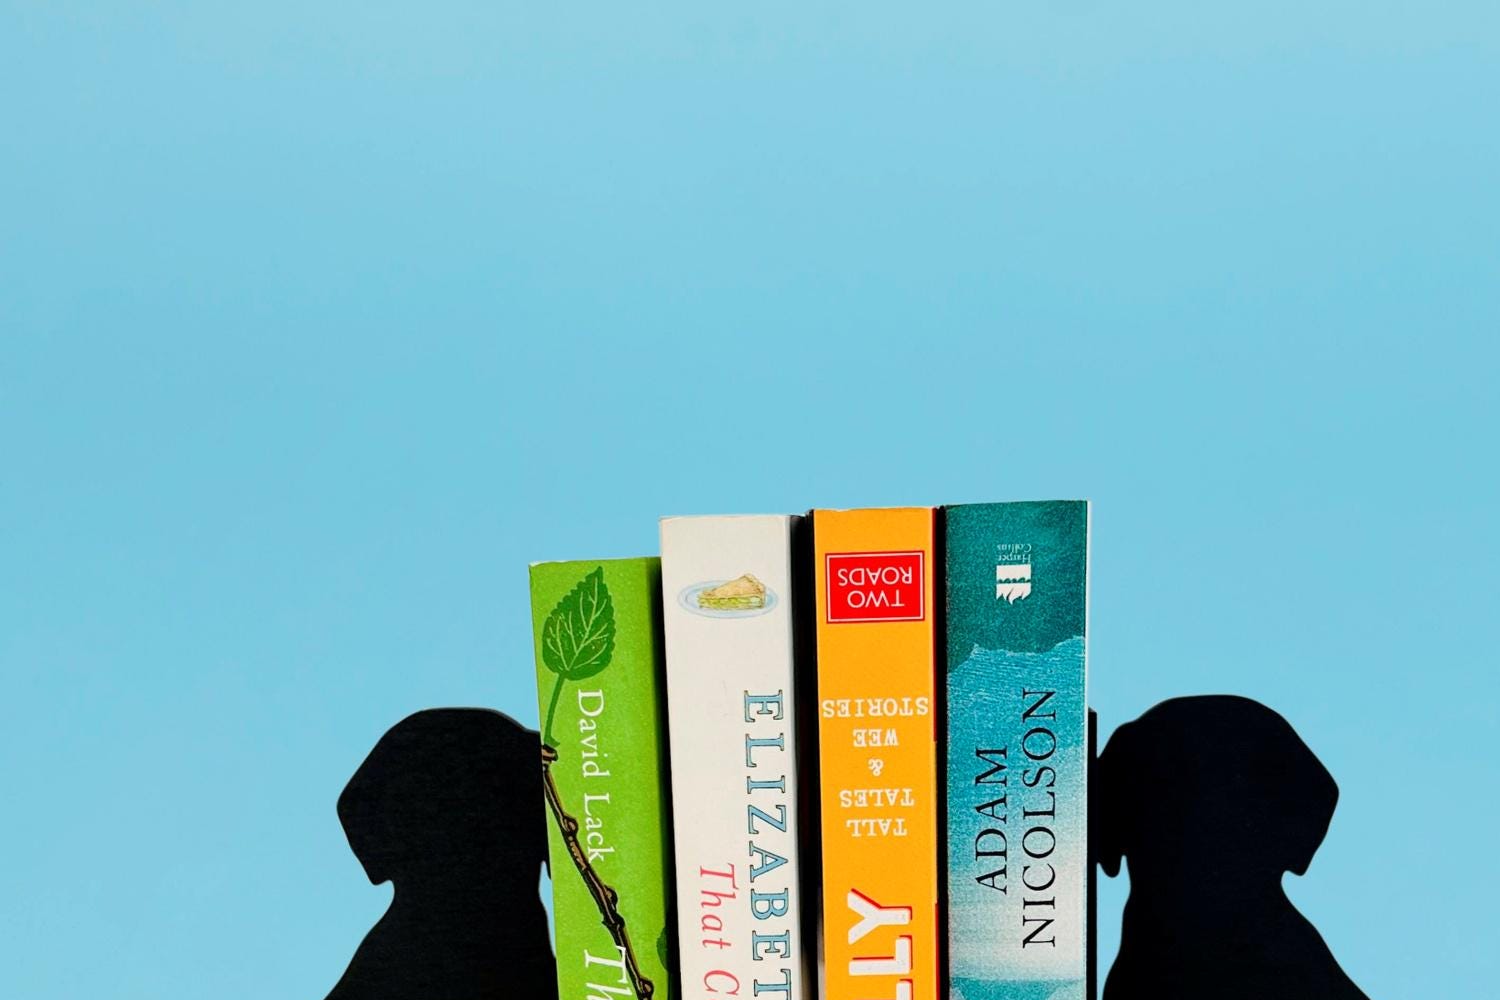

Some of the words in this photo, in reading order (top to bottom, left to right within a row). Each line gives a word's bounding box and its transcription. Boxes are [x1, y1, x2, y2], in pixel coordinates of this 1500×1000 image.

[838, 566, 913, 586] ROADS
[847, 589, 904, 608] TWO
[822, 696, 929, 718] STORIES
[577, 688, 611, 778] David
[852, 728, 899, 748] WEE
[868, 758, 884, 777] &
[840, 788, 915, 807] TALES
[584, 791, 615, 863] Lack
[847, 817, 908, 837] TALL
[974, 745, 1008, 896] ADAM
[1022, 688, 1056, 948] NICOLSON
[699, 862, 740, 949] That
